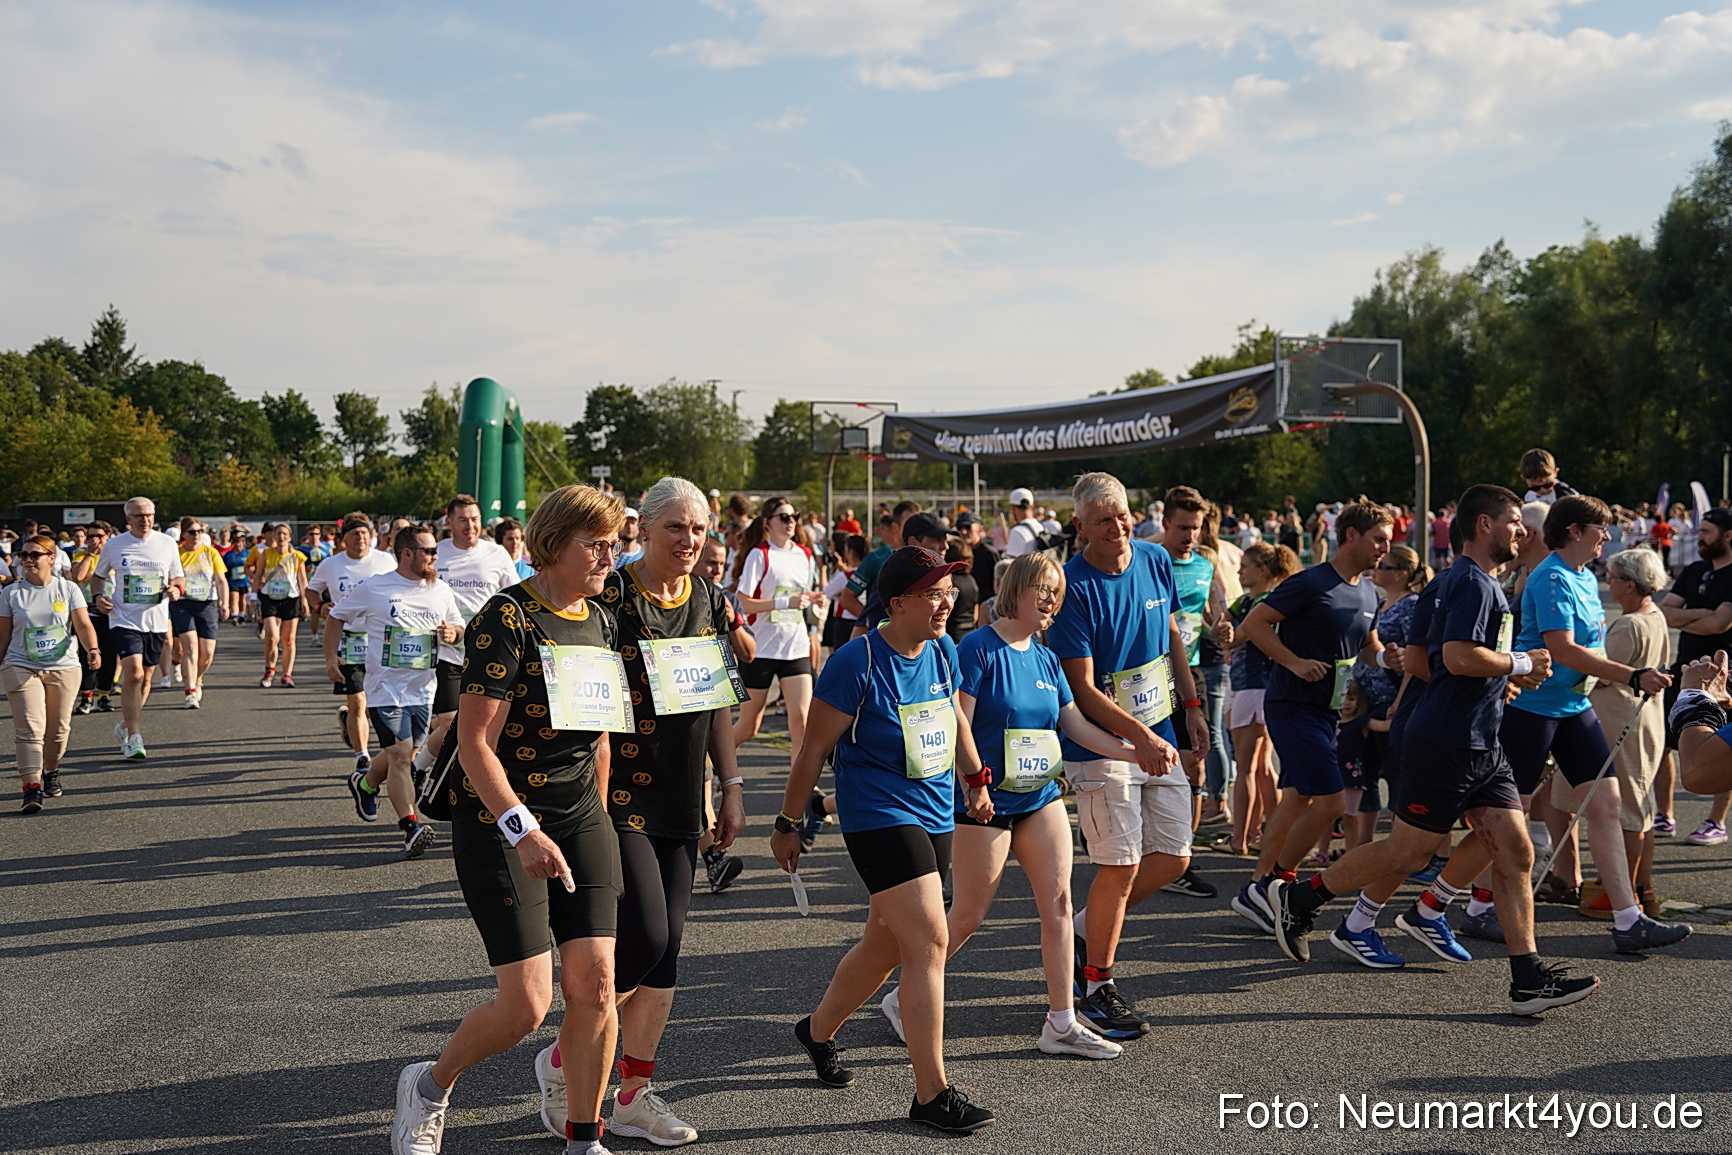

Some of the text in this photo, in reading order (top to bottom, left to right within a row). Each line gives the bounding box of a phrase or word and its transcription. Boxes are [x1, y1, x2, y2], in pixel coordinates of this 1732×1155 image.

[934, 412, 1180, 460] Hier gewinnt das Miteinander.
[448, 579, 491, 588] Silberhorn
[35, 639, 57, 648] 1972
[399, 643, 421, 652] 1574
[673, 667, 711, 684] 2103
[572, 681, 610, 699] 2078
[679, 686, 695, 694] Karin
[1132, 686, 1159, 706] 1477
[599, 702, 616, 713] Bogner
[920, 731, 946, 749] 1481
[1018, 758, 1049, 771] 1476
